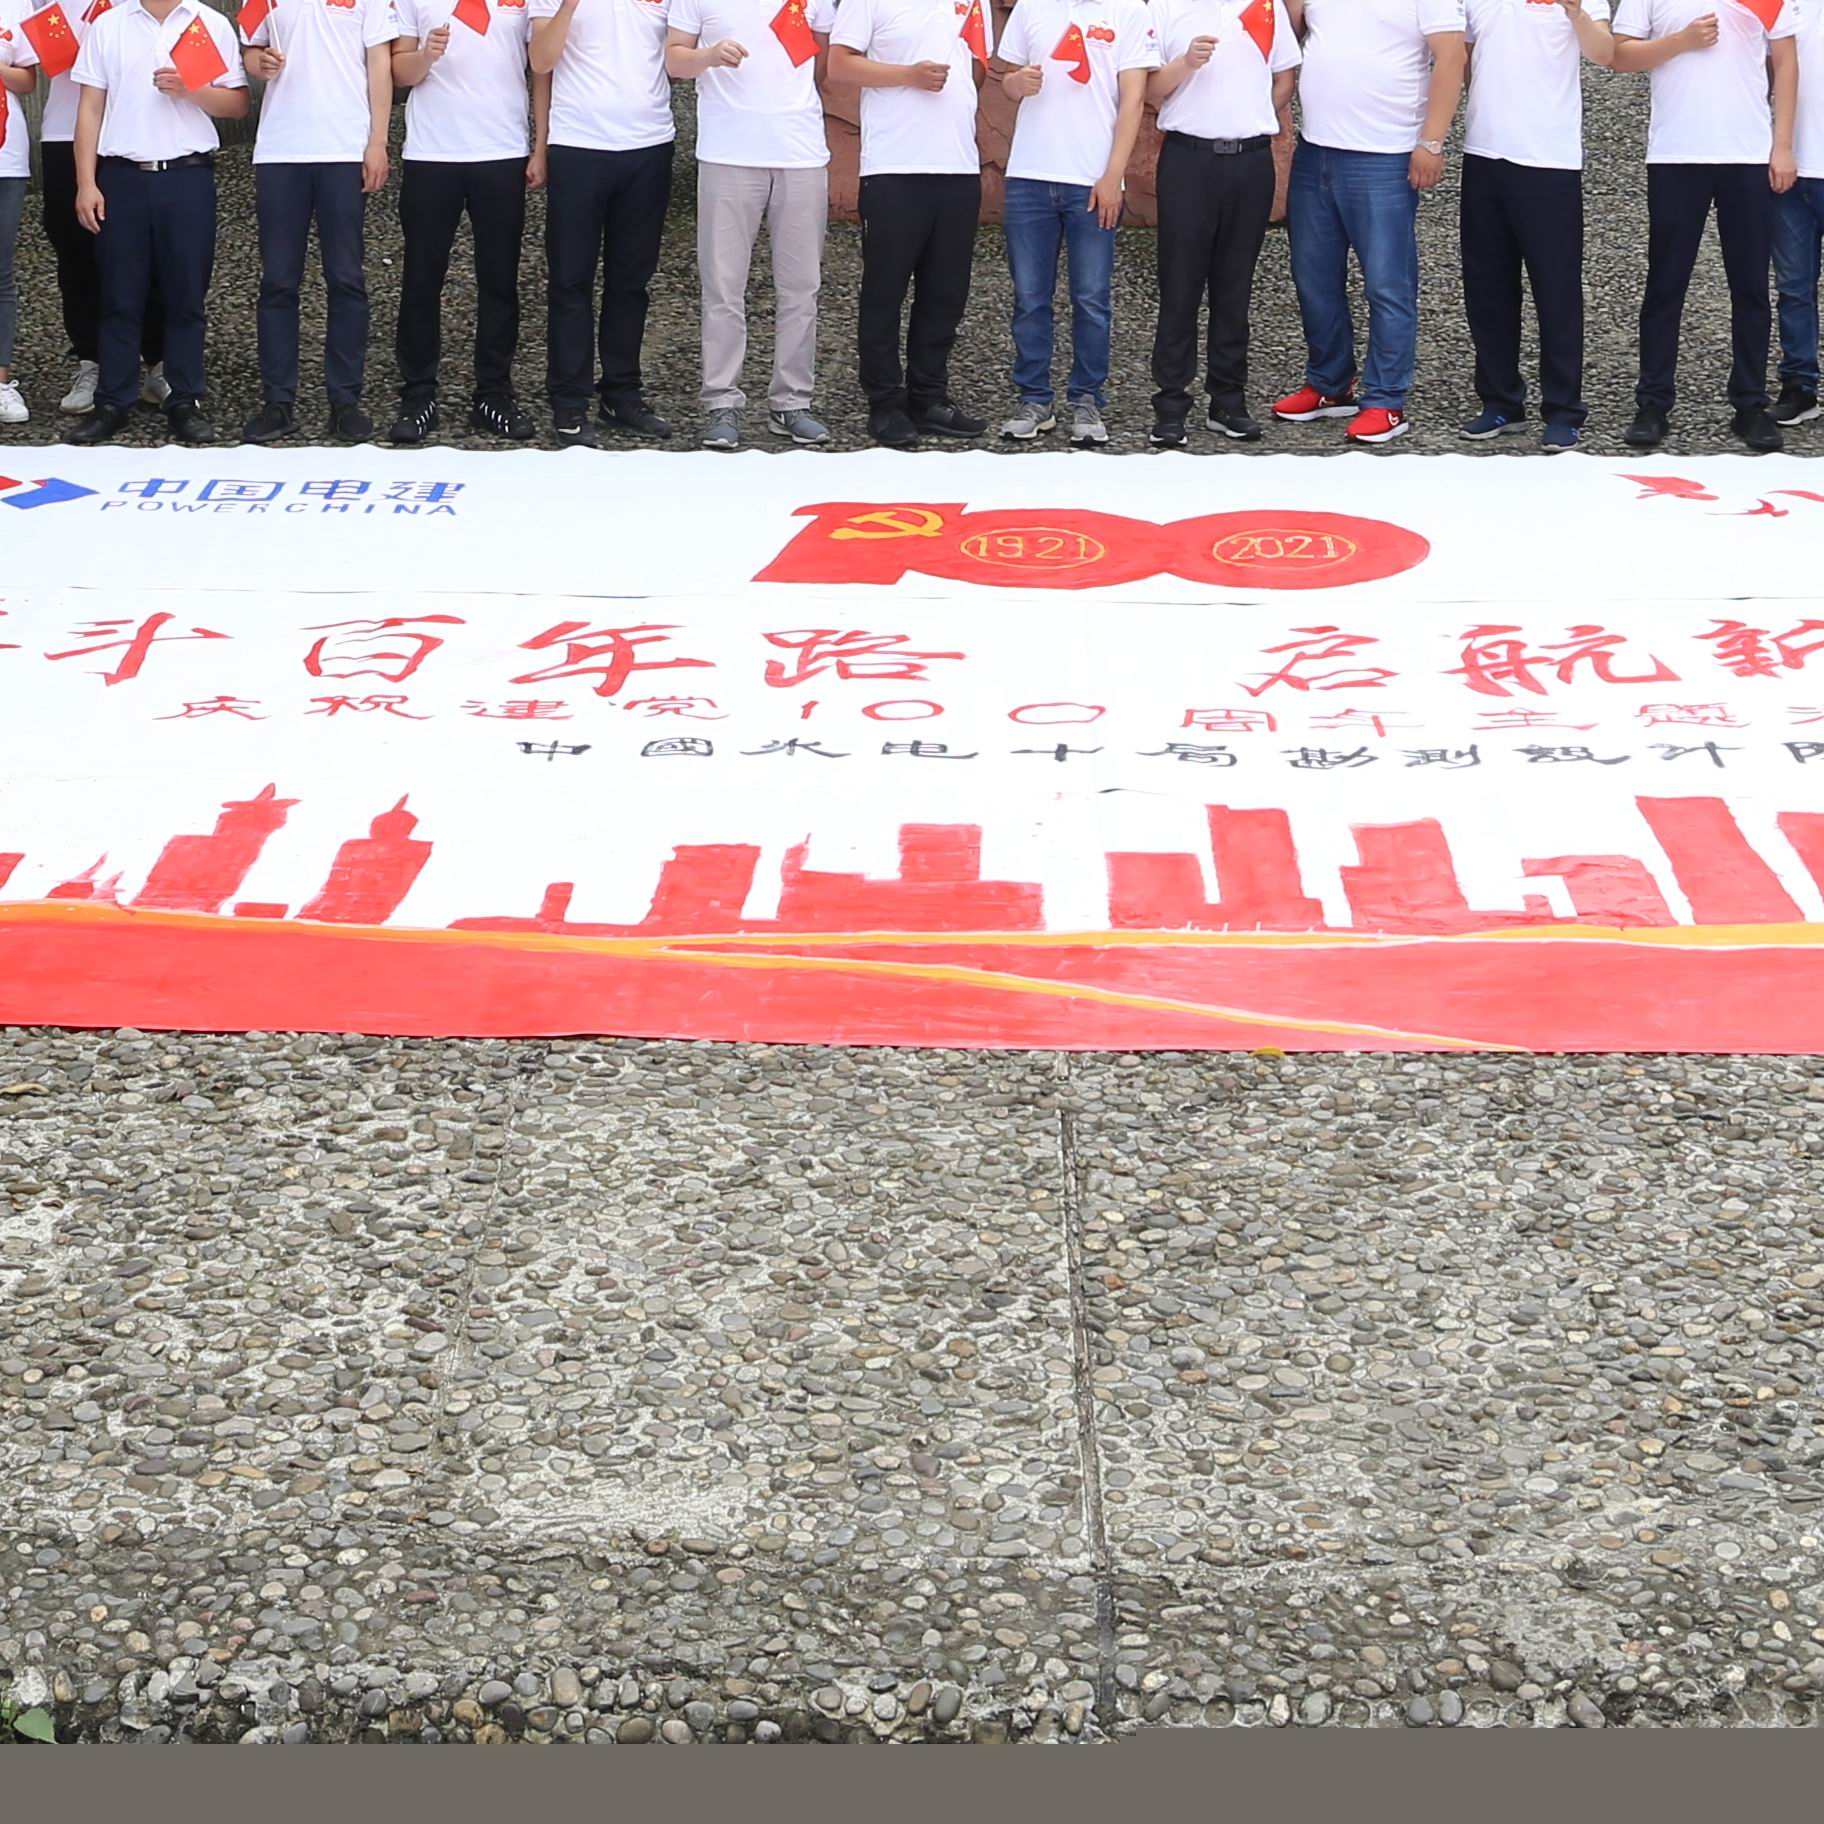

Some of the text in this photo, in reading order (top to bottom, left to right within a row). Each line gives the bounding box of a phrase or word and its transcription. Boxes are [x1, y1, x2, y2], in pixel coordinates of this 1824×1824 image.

[118, 477, 466, 504] 中国电建
[100, 501, 458, 516] POWERCHINA
[976, 535, 1088, 560] 1921
[1229, 535, 1339, 560] 2021
